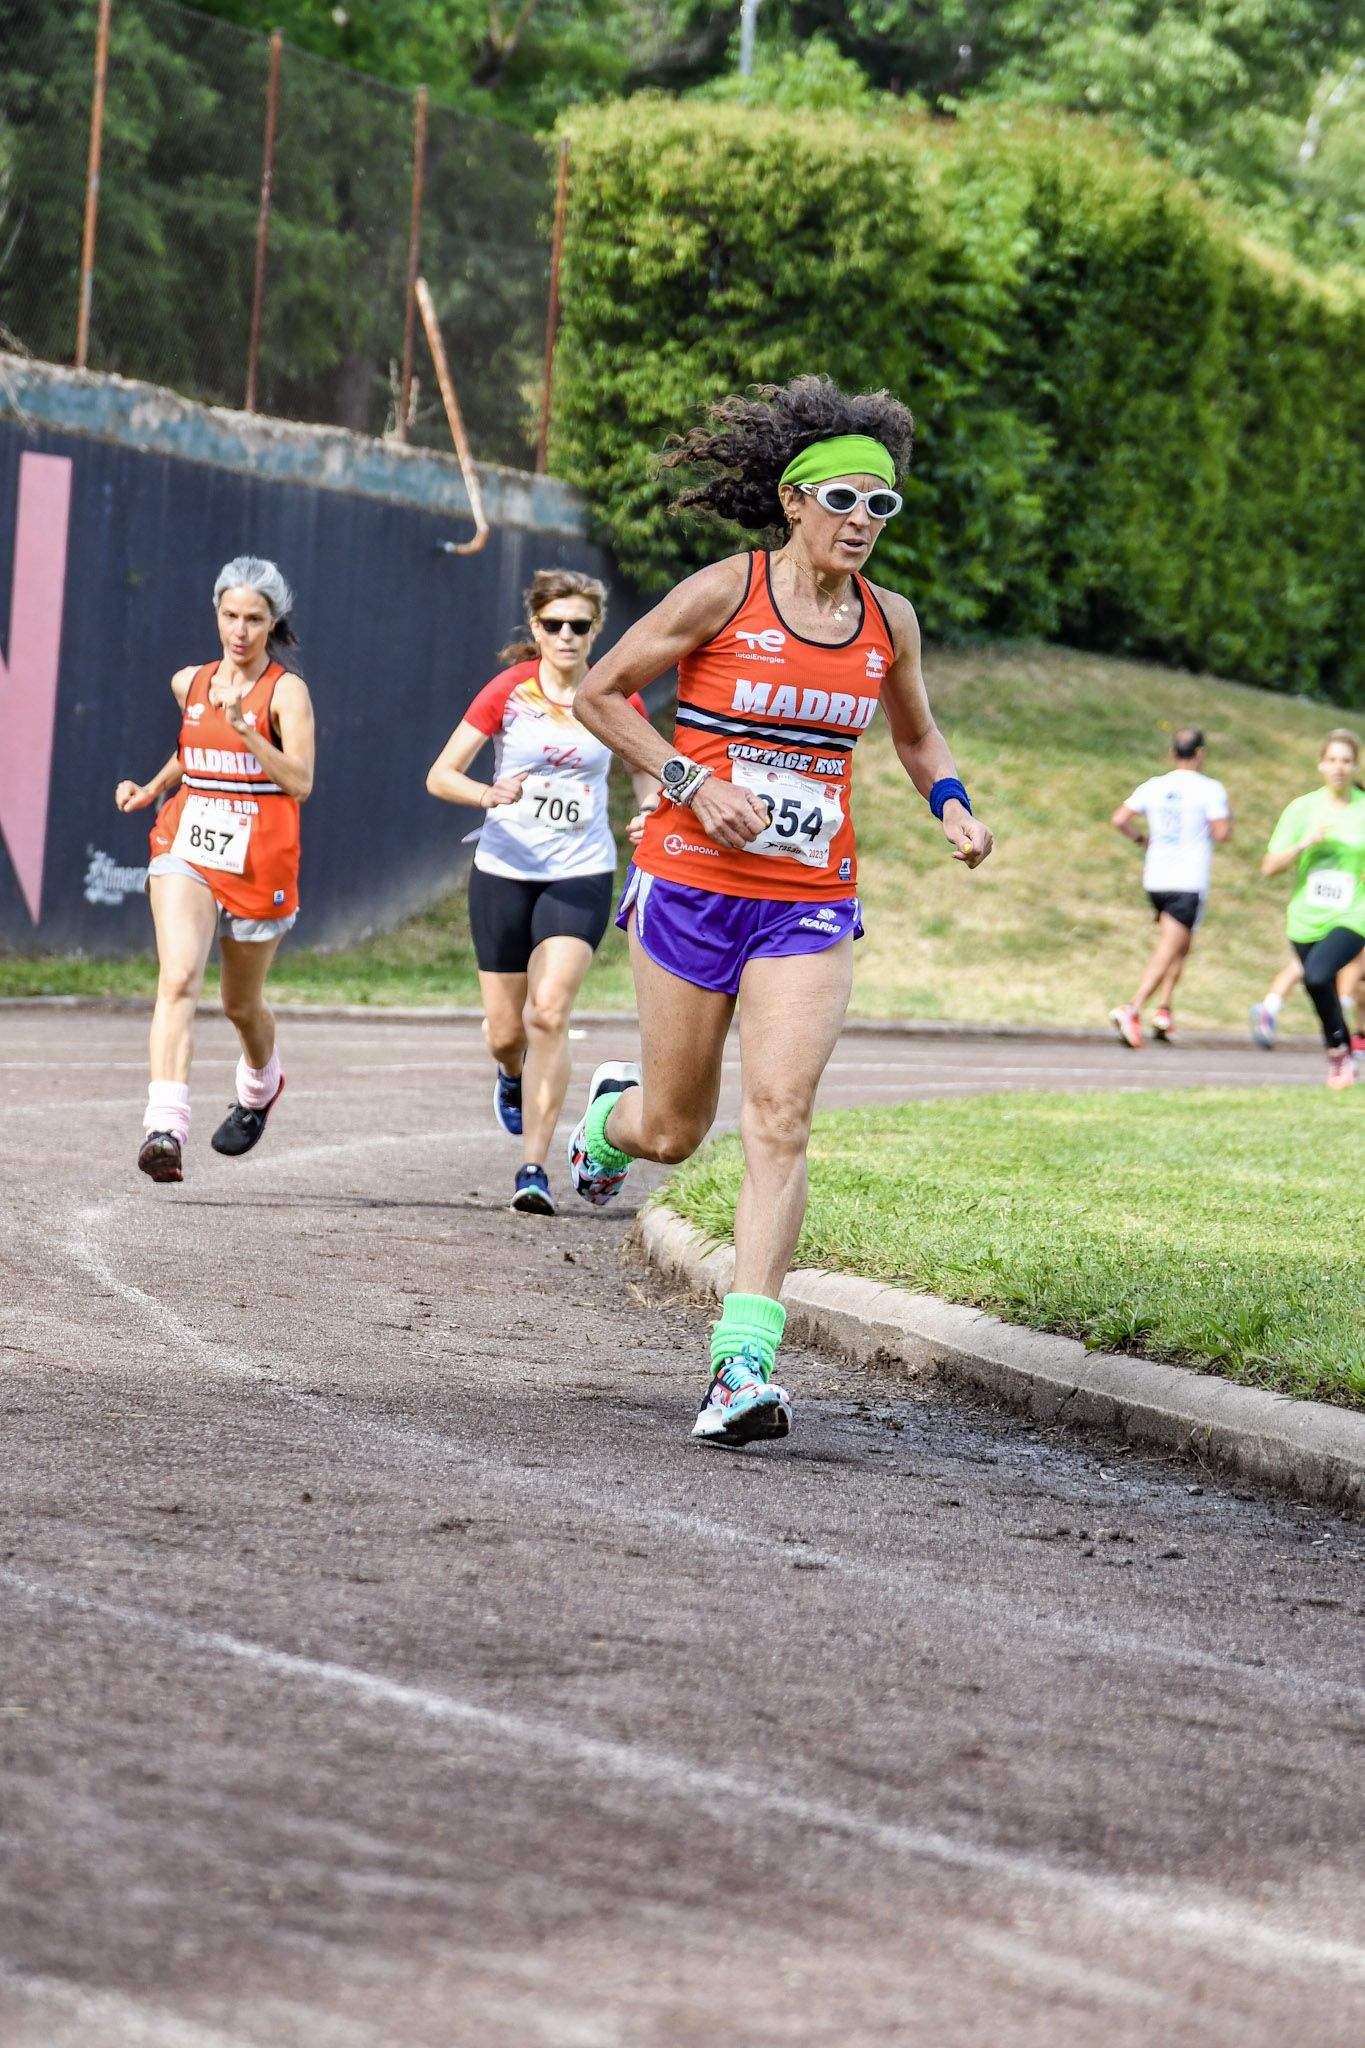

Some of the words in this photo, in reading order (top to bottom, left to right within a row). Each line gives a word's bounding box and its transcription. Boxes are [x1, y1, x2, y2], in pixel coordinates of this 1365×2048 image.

[533, 795, 580, 823] 706
[190, 824, 234, 856] 857
[680, 843, 720, 857] MAPOMA
